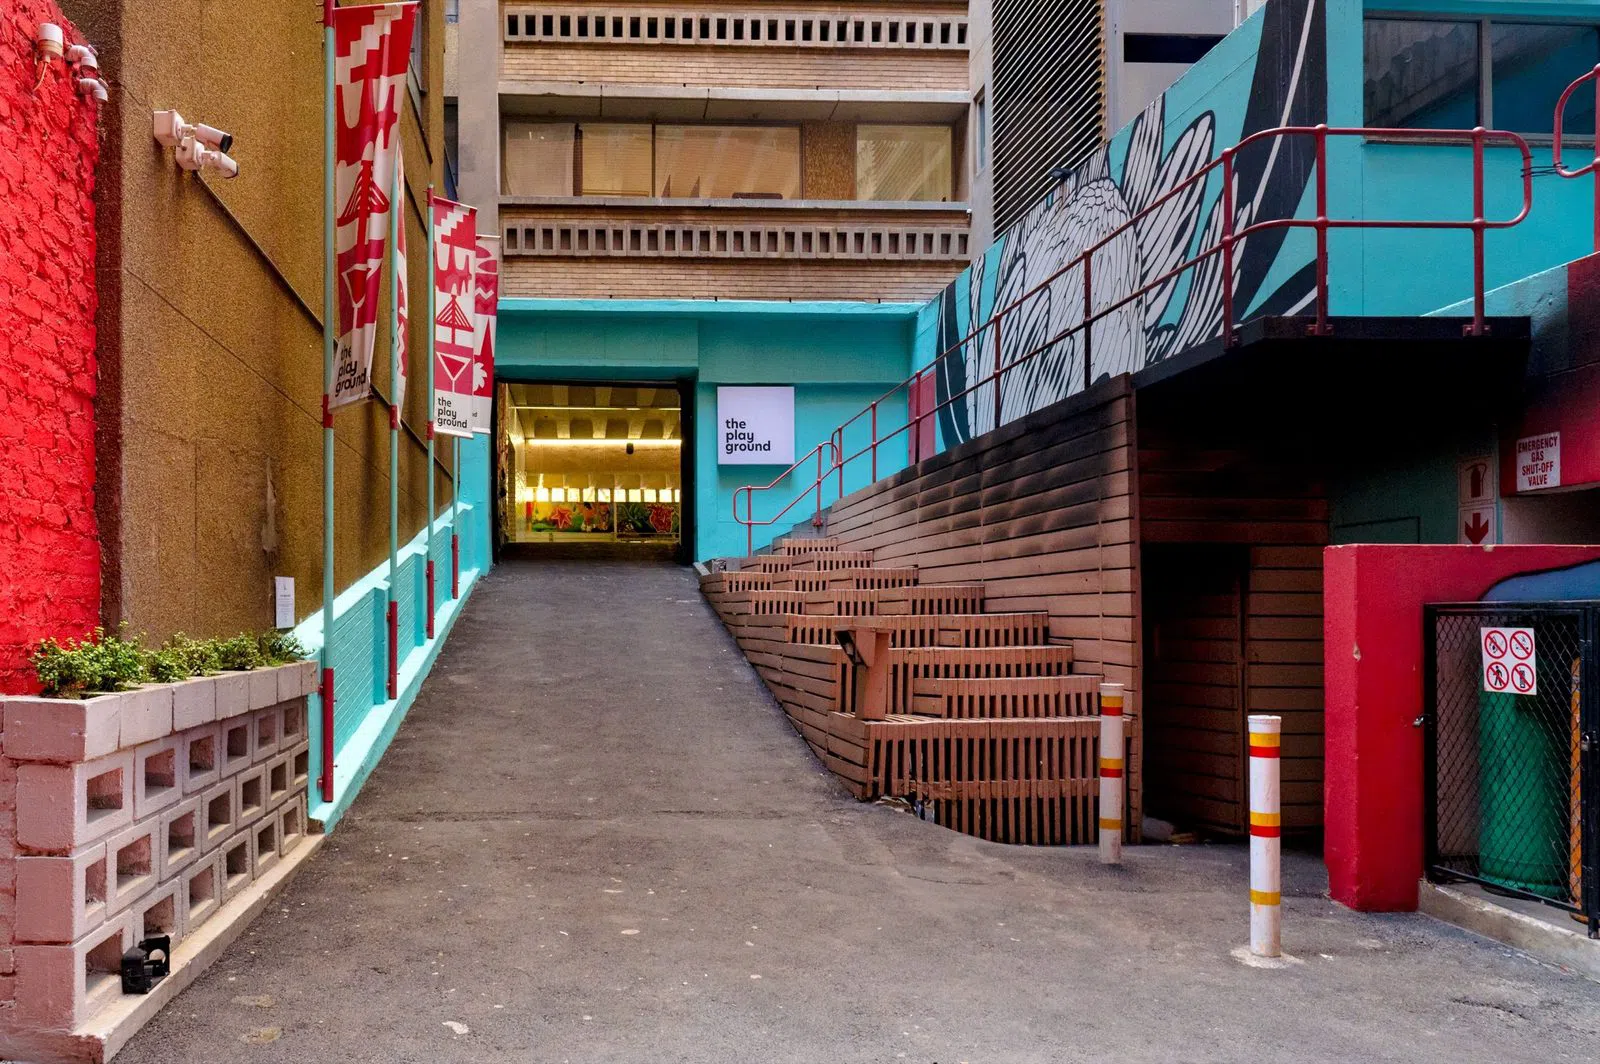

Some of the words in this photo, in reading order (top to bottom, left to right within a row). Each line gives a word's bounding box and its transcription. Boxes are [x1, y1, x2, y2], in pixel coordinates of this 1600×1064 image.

[337, 360, 357, 381] play
[335, 367, 367, 397] ground
[438, 397, 452, 407] the
[437, 407, 457, 420] play
[437, 417, 467, 428] ground
[725, 418, 746, 429] the
[725, 429, 754, 443] play
[725, 440, 771, 454] ground
[1517, 436, 1558, 453] EMERGENCY
[1531, 450, 1544, 462] GAS
[1521, 461, 1554, 476] SHUT-OFF
[1527, 474, 1547, 486] VALVE
